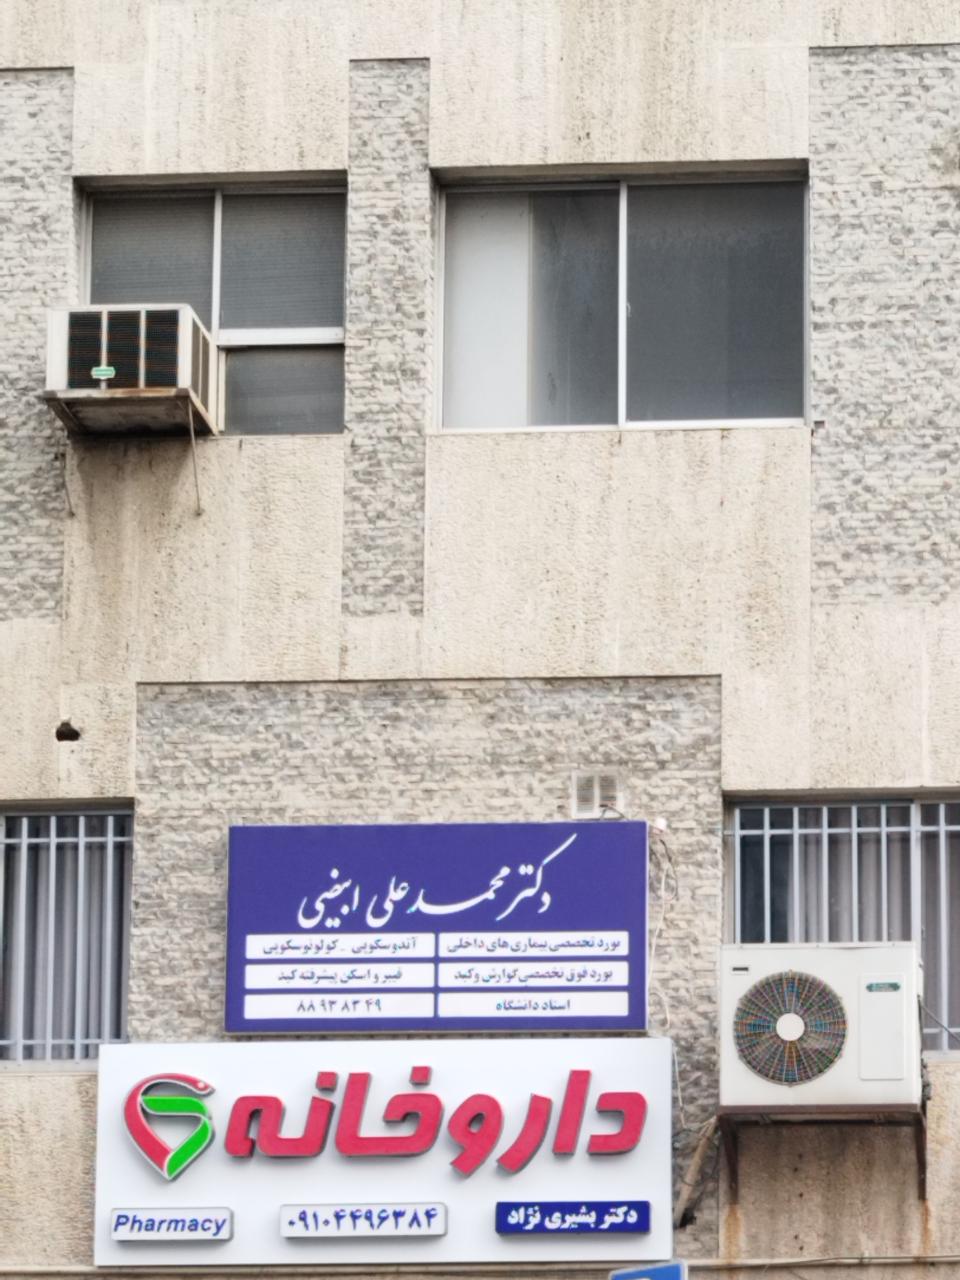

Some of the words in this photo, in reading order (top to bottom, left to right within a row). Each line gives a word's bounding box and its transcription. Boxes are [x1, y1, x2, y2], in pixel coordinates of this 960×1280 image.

[406, 866, 511, 915] محمد
[496, 833, 577, 921] دکتر
[366, 876, 410, 929] علی
[224, 1066, 650, 1179] داروخانه
[113, 1214, 228, 1237] Pharmacy
[288, 1207, 438, 1231] ۰۹۱۰۴۴۹۶۳۸۴
[506, 1204, 542, 1231] نژاد
[544, 1204, 597, 1231] بشیری
[598, 1204, 639, 1231] دکتر
